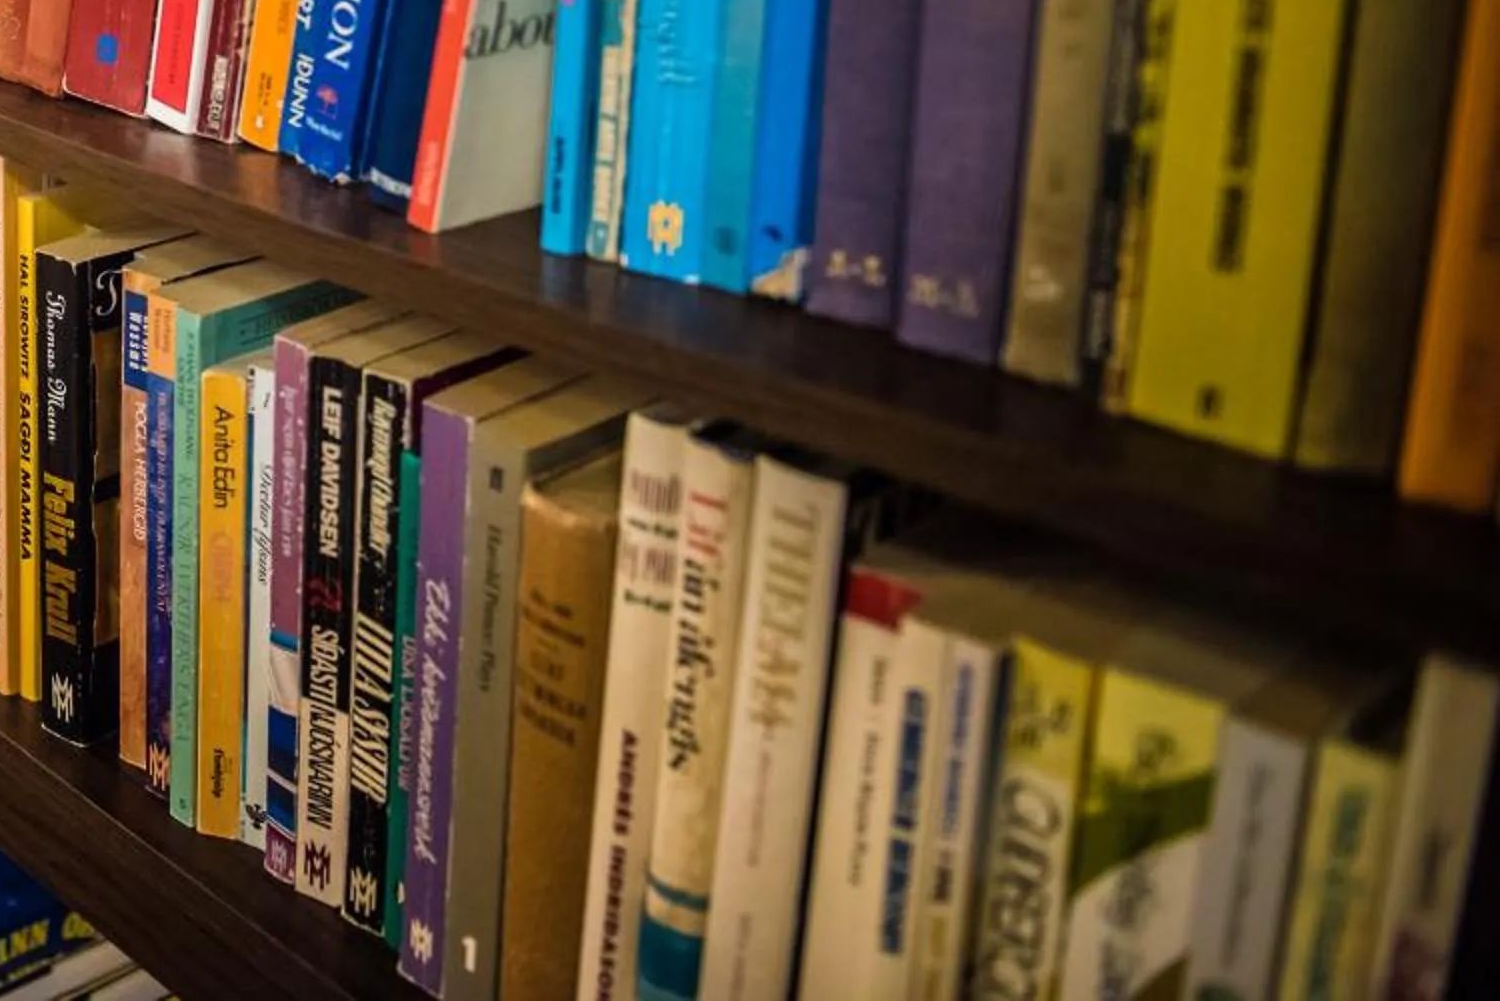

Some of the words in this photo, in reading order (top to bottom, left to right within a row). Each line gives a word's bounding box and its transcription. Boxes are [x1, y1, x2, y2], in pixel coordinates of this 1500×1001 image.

[19, 254, 29, 289] HAL
[19, 294, 29, 380] SIROWITZ
[45, 290, 67, 372] Thomas
[45, 376, 67, 442] Mann
[213, 406, 236, 462] Anita
[322, 385, 343, 440] LEIF
[20, 467, 32, 560] MAMMA
[43, 471, 76, 557] Felix
[213, 467, 236, 509] Edin
[319, 441, 342, 558] DAVIDSEN
[44, 558, 78, 646] Krull
[307, 704, 342, 830] NJÓSNARINN
